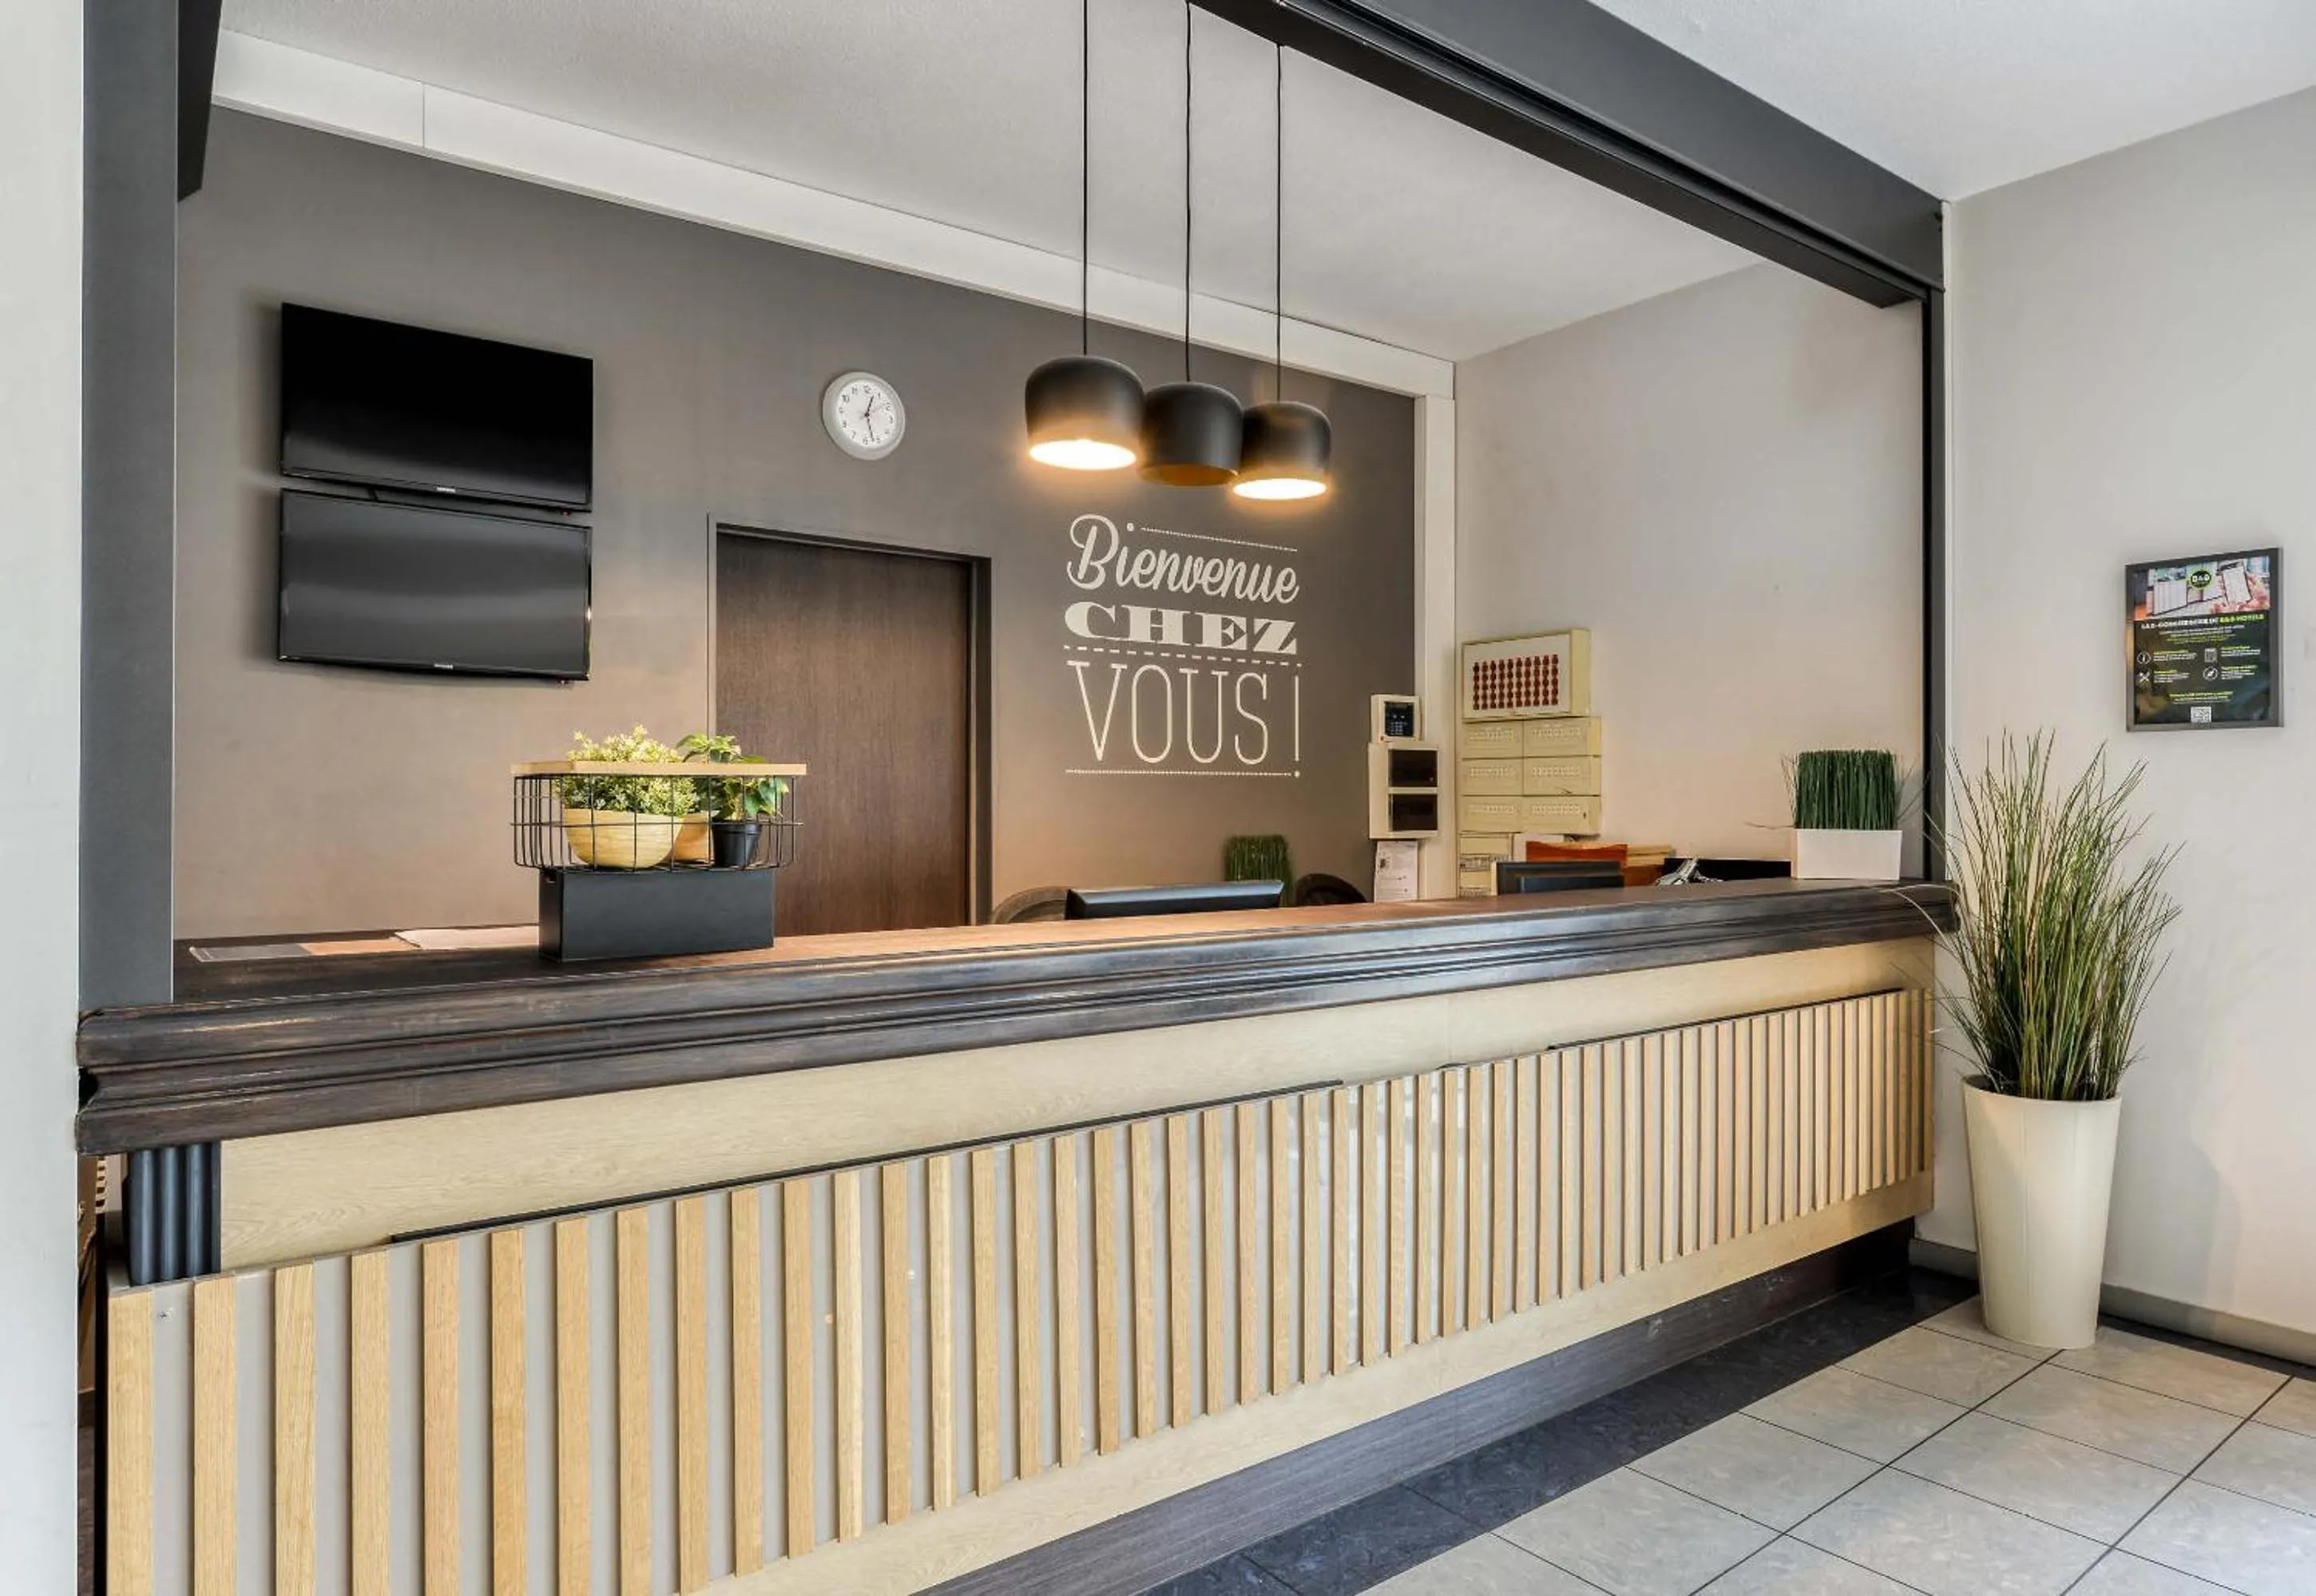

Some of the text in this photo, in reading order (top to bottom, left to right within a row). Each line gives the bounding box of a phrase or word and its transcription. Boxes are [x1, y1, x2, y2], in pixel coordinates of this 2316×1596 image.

[1066, 513, 1300, 604] Bienvenue
[1064, 601, 1298, 655] CHEZ
[1066, 660, 1268, 765] VOUS
